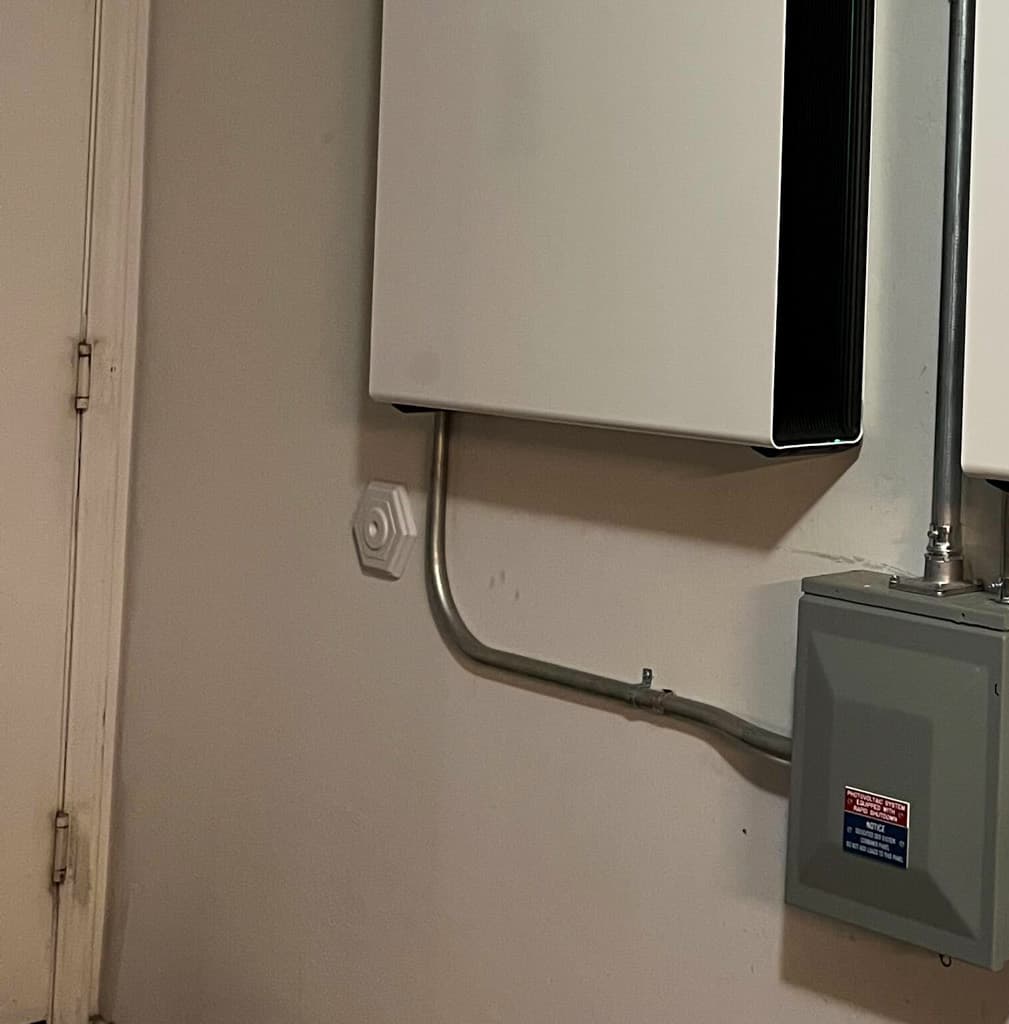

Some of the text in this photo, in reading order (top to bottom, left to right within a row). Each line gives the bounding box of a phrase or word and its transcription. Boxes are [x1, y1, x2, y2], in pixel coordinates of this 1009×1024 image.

[847, 790, 906, 811] PHOTOVOLTAIC SYSTEM
[856, 799, 896, 815] EQUIPPED WITH
[853, 805, 898, 822] RAPID SHUTDOWN
[866, 821, 885, 833] NOTICE
